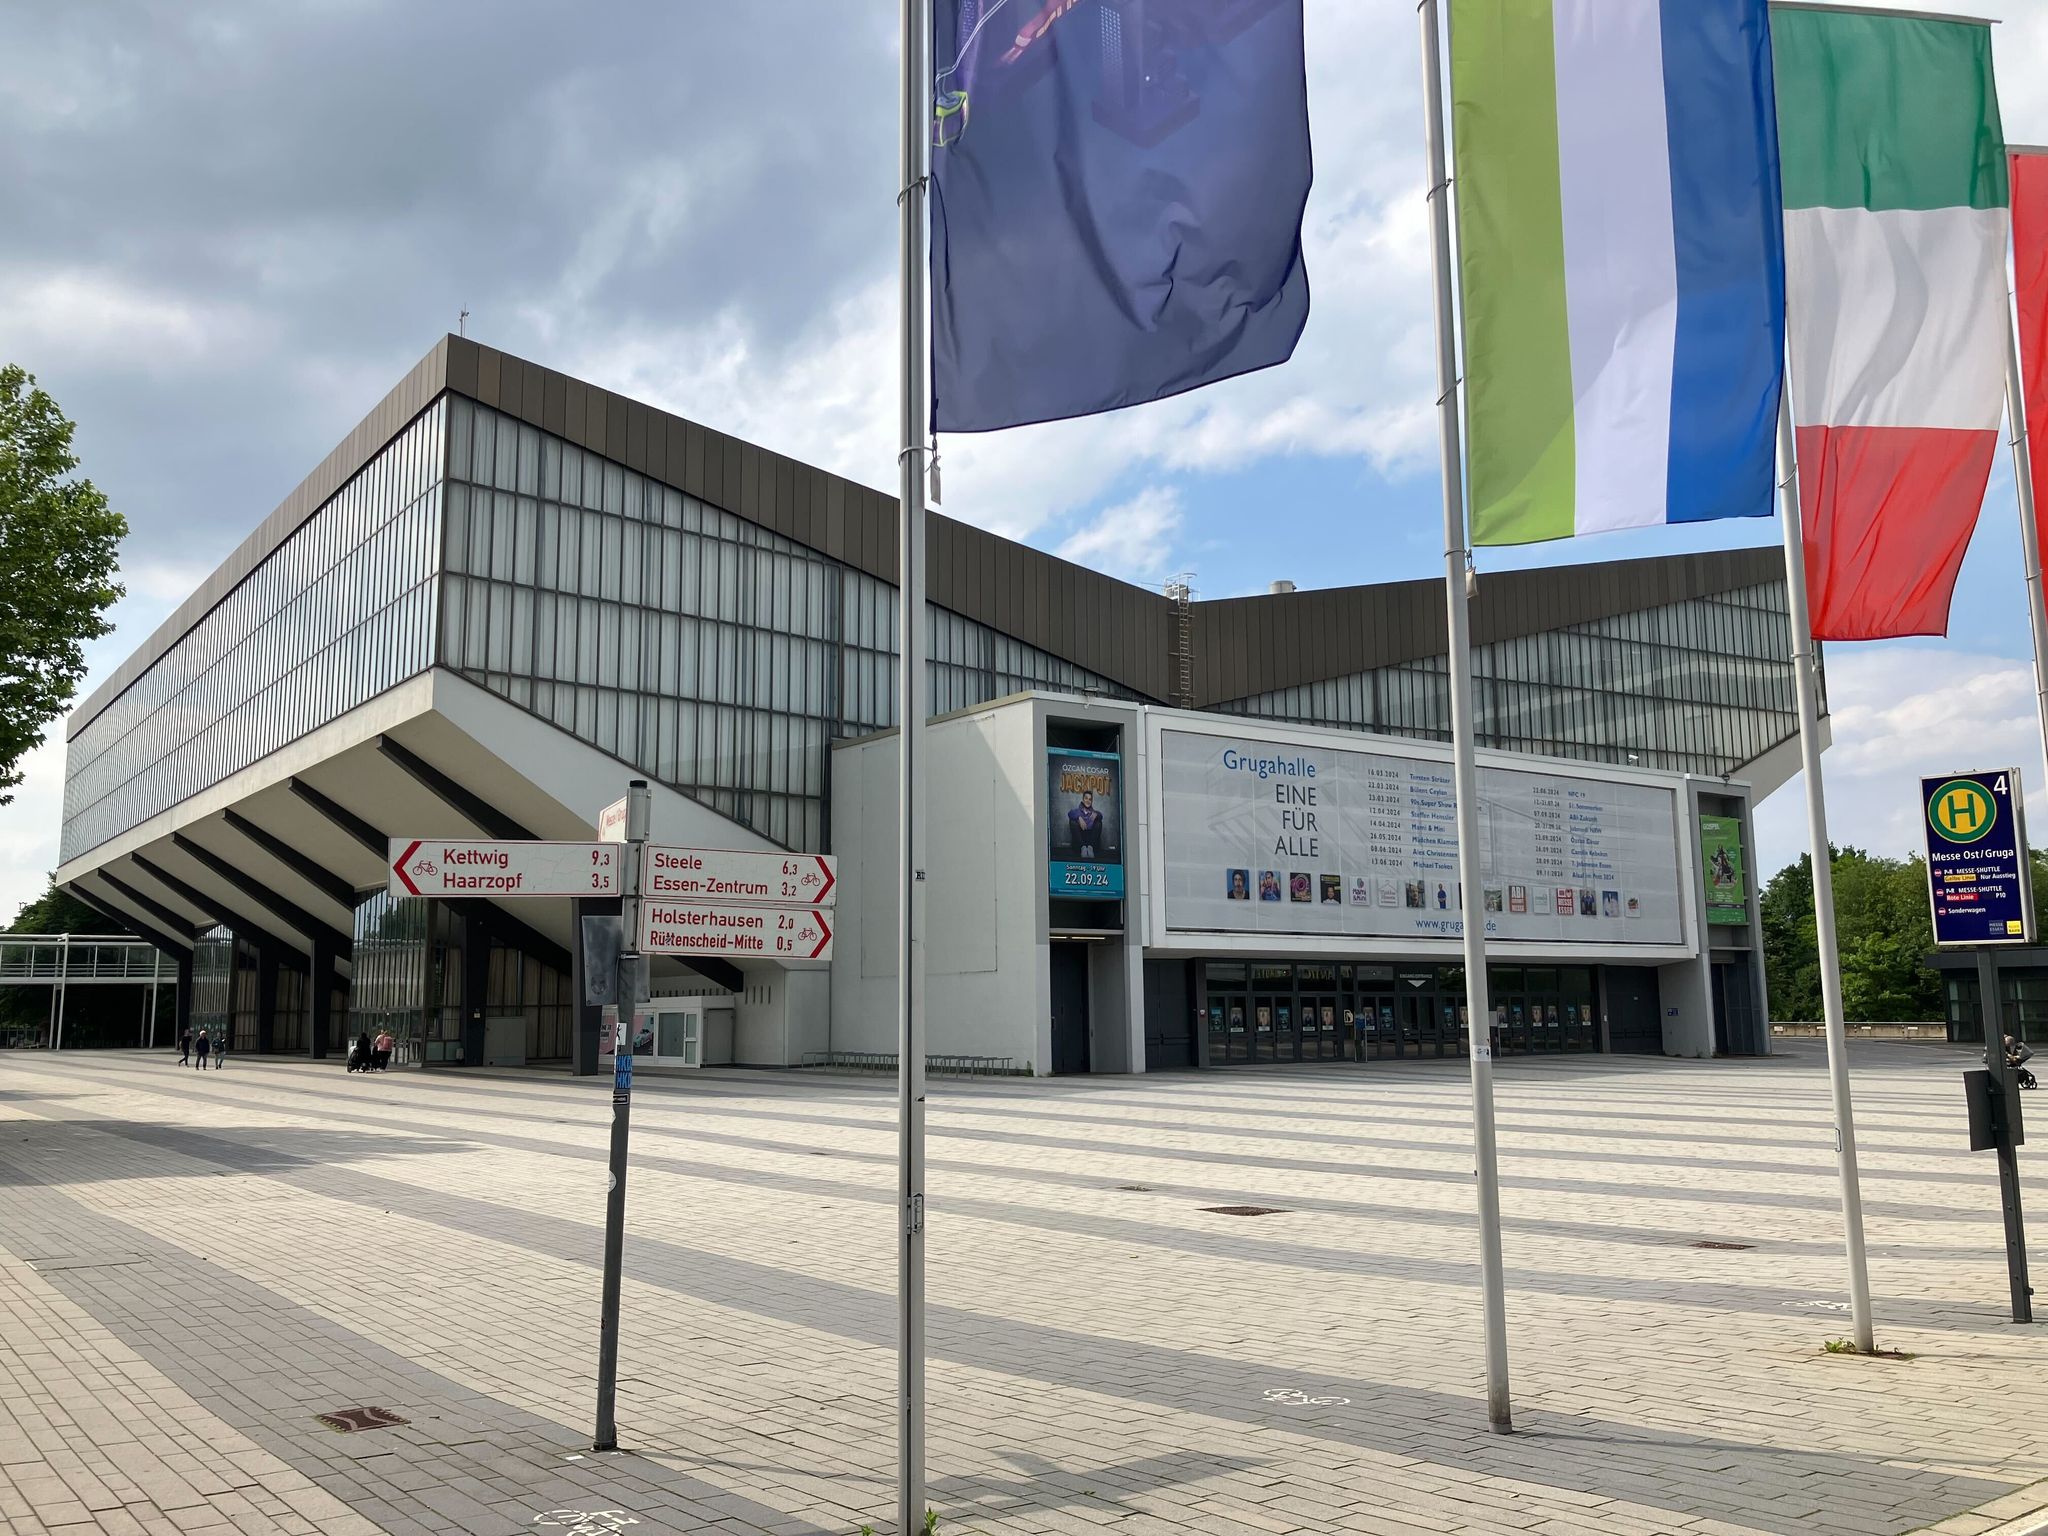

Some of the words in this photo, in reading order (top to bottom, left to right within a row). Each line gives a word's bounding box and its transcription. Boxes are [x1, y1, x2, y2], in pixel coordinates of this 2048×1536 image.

[1224, 750, 1316, 778] Grugahalle
[1276, 784, 1316, 806] EINE
[1994, 775, 2008, 795] 4
[1282, 807, 1317, 832] FÜR
[1947, 794, 1976, 828] H
[1275, 836, 1318, 857] ALLE
[444, 849, 508, 868] Kettwig
[591, 850, 610, 866] 9,3
[654, 853, 702, 869] Steele
[782, 861, 797, 875] 6,3
[1932, 853, 1960, 862] Messe
[1065, 873, 1108, 885] 22.09.24
[1957, 866, 2000, 874] MESSE-SHUTTLE
[443, 872, 522, 892] Haarzopf
[591, 873, 609, 889] 3,5
[654, 876, 768, 895] Essen-Zentrum
[782, 882, 796, 896] 3,2
[652, 908, 763, 928] Holsterhausen
[778, 915, 793, 930] 2,0
[776, 936, 792, 951] 0,5
